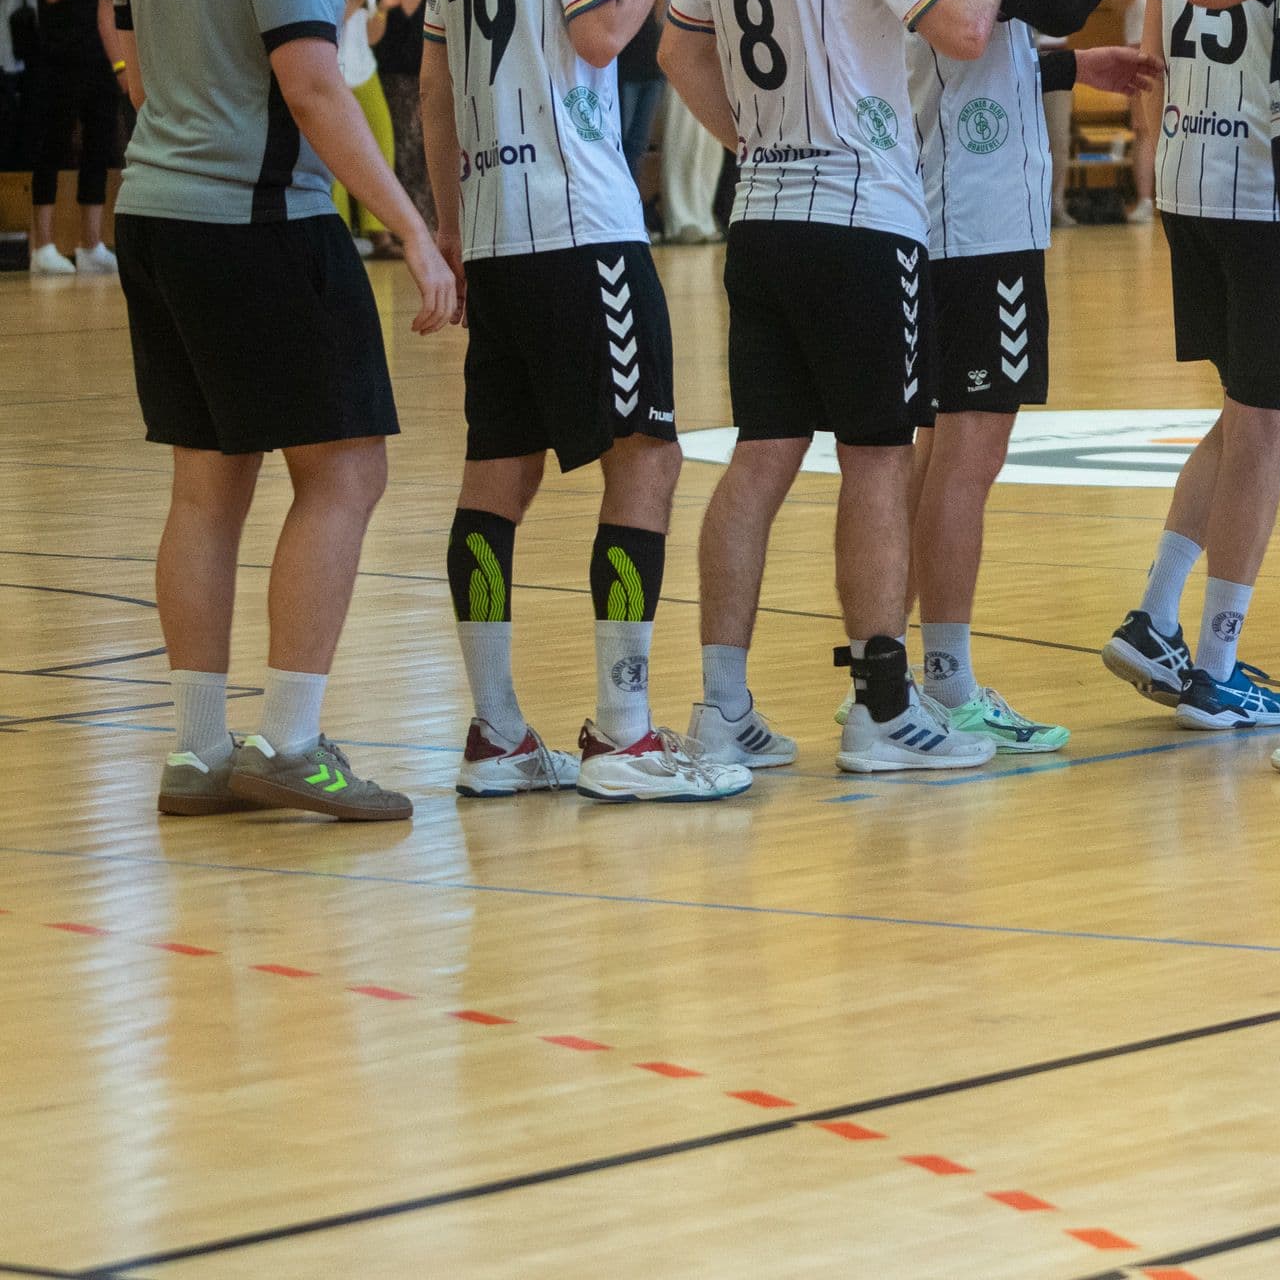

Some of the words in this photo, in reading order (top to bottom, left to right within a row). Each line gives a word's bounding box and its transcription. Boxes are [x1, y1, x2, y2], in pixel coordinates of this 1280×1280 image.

[1170, 1, 1249, 65] 25
[960, 100, 988, 122] BERLINER
[989, 102, 1005, 120] BERG
[1182, 110, 1249, 139] quirion
[966, 139, 1001, 150] BRAUEREI
